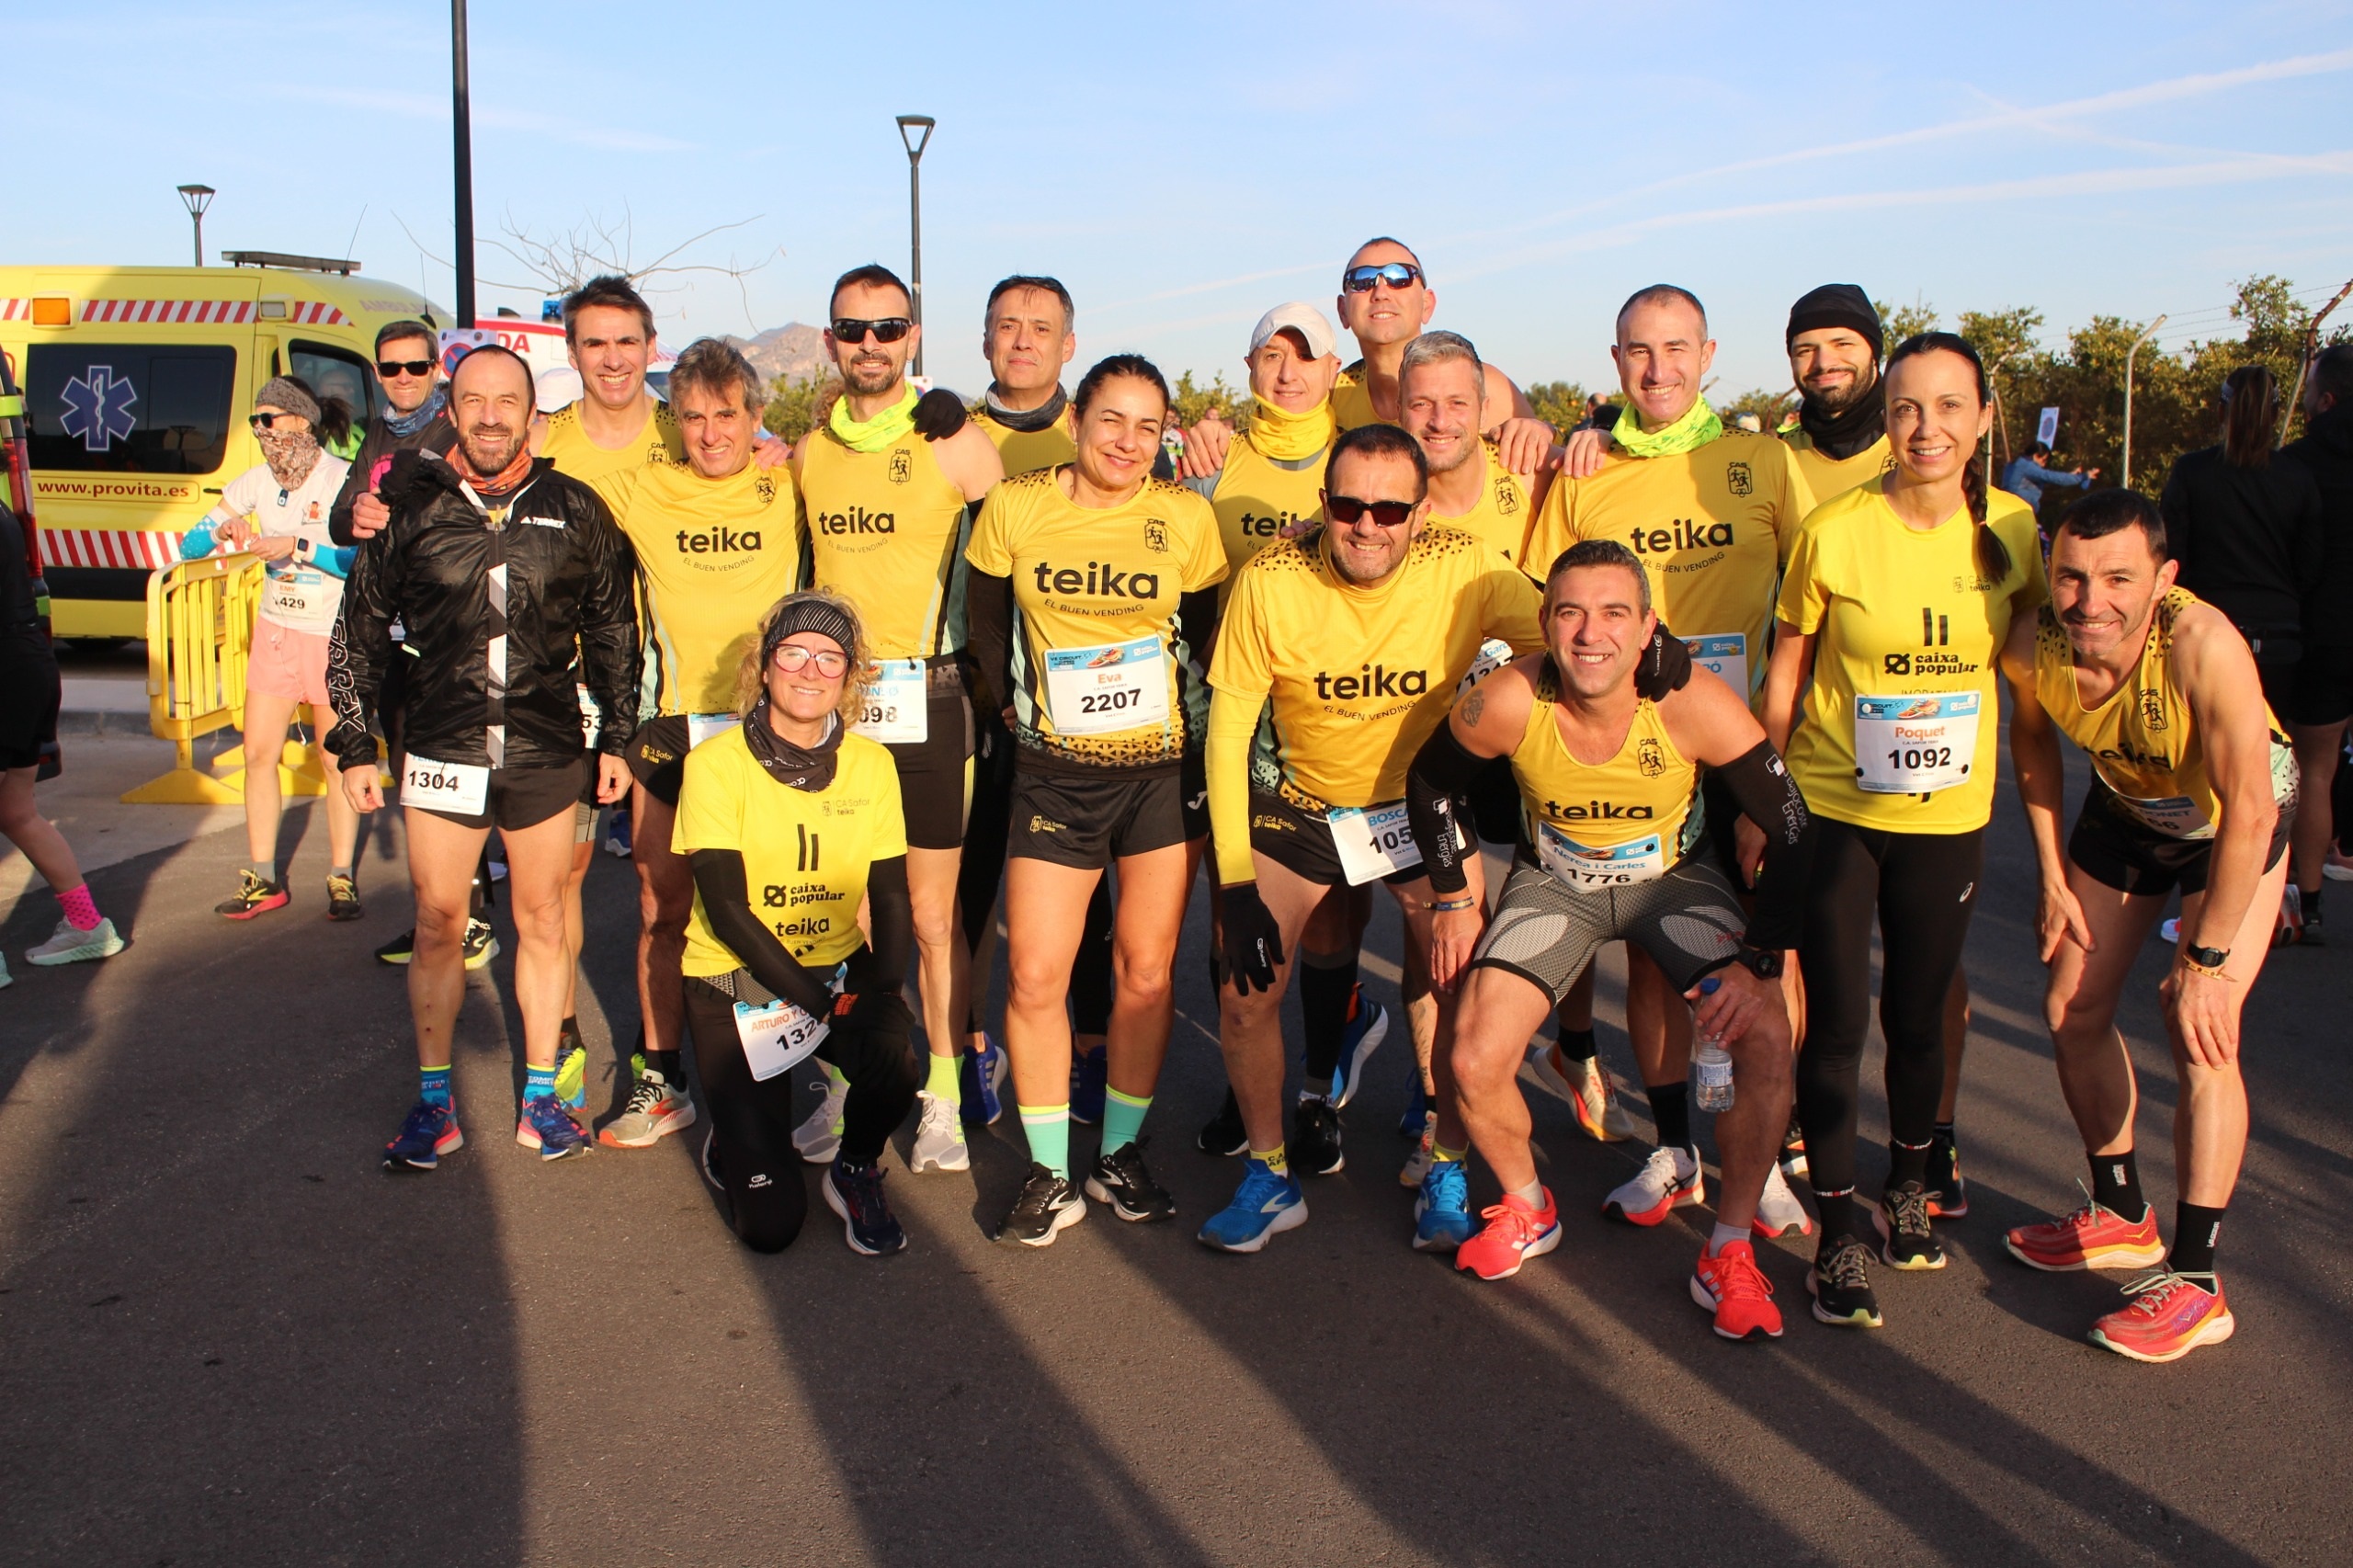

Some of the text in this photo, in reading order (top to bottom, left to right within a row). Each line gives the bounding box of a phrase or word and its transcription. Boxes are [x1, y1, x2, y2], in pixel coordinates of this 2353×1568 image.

[38, 482, 189, 497] www.provita.es
[819, 506, 895, 535] teika
[676, 526, 762, 553] teika
[1247, 540, 1256, 550] EL
[1631, 518, 1733, 554] teika
[828, 538, 888, 553] EL BUEN VENDING
[683, 554, 755, 572] EL BUEN VENDING
[1643, 551, 1725, 573] EL BUEN VENDING
[1034, 561, 1158, 599] teika
[1044, 598, 1144, 617] EL BUEN VENDING
[1915, 653, 1959, 663] caixa
[1097, 673, 1122, 684] Eva
[1915, 663, 1978, 676] popular
[1313, 664, 1427, 699] teika
[1081, 688, 1142, 713] 2207
[1324, 700, 1416, 722] EL BUEN VENDING
[1895, 726, 1946, 741] Poquet
[655, 750, 673, 762] Safor
[1888, 747, 1951, 769] 1092
[409, 770, 460, 791] 1304
[837, 808, 854, 816] teika
[1545, 801, 1654, 819] teika
[1264, 822, 1281, 831] teika
[1267, 815, 1297, 832] CA Safor
[1554, 846, 1590, 869] Nerea
[1603, 861, 1646, 870] Carles
[1567, 868, 1631, 884] 1776
[790, 882, 826, 894] caixa
[790, 892, 845, 907] popular
[776, 917, 830, 937] teika
[751, 1013, 790, 1032] ARTURO
[790, 1009, 797, 1019] Y
